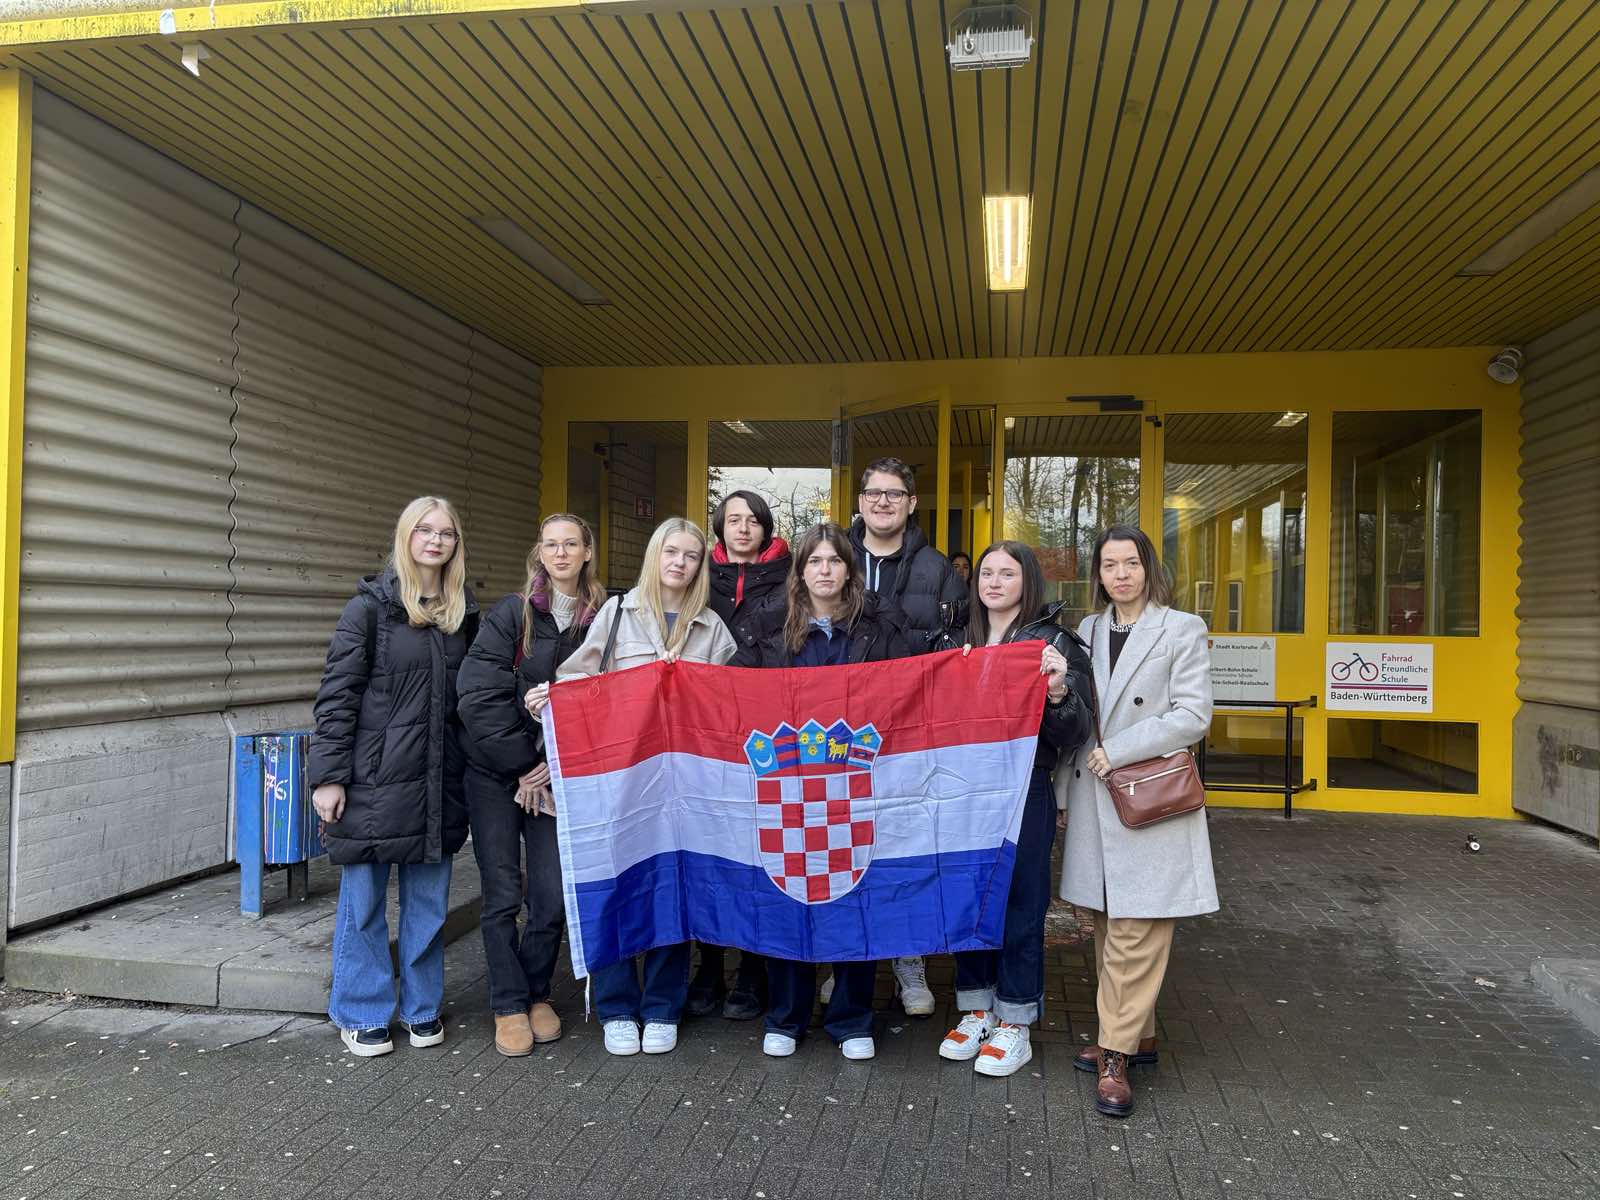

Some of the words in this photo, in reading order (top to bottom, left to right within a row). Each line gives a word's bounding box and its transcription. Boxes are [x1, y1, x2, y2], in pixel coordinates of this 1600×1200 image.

[1381, 653, 1413, 663] Fahrrad
[1381, 664, 1429, 673] Freundliche
[1381, 674, 1409, 683] Schule
[1330, 691, 1428, 705] Baden-Württemberg
